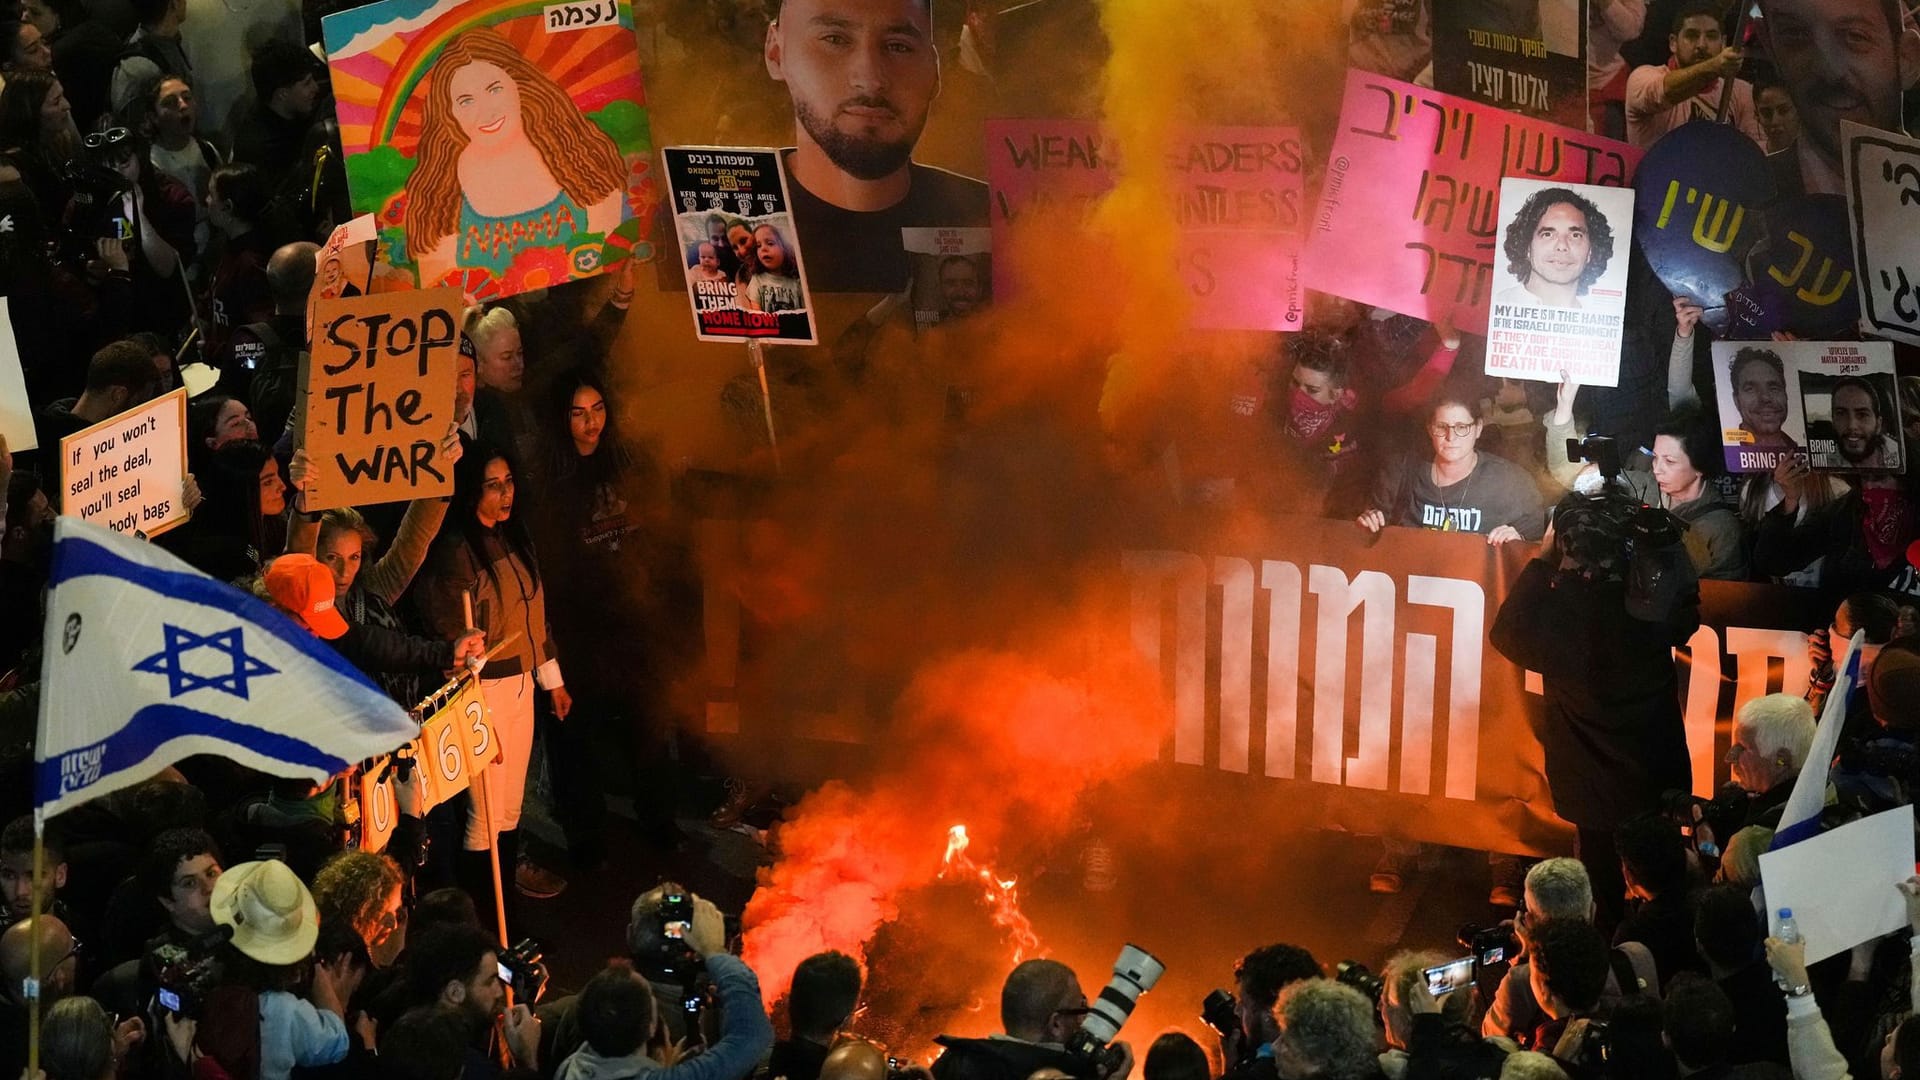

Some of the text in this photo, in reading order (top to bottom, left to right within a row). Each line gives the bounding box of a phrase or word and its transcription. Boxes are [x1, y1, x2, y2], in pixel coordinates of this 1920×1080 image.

[550, 0, 617, 28] נעמה
[1467, 28, 1547, 59] הופקר למוות בשבי
[1467, 60, 1550, 112] אלעד קציר
[1350, 82, 1627, 190] גדעון ויריב
[687, 153, 755, 167] משפחת ביבס
[680, 190, 778, 202] KFIR YARDEN SHIRI ARIEL
[463, 203, 577, 260] NAAMA
[696, 281, 738, 296] BRING
[698, 295, 737, 311] THEM
[1494, 304, 1512, 317] MY
[1513, 306, 1539, 319] LIFE
[1540, 309, 1548, 319] IS
[1557, 310, 1580, 323] THE
[1581, 312, 1621, 327] HANDS
[702, 311, 780, 328] HOME NOW!
[1502, 318, 1513, 329] THE
[1513, 320, 1552, 333] ISRAELI
[1553, 323, 1619, 339] GOVERNMENT
[323, 308, 456, 377] STOP
[1492, 331, 1500, 341] IF
[1503, 332, 1528, 344] THEY
[1529, 333, 1558, 346] DON'T
[1591, 339, 1617, 351] DEAL
[1492, 341, 1524, 355] THEY
[1525, 344, 1549, 358] ARE
[1490, 354, 1537, 371] DEATH
[326, 383, 432, 435] The
[72, 416, 156, 466] If you won't
[1810, 439, 1836, 454] BRING
[71, 447, 152, 496] seal the deal,
[335, 440, 445, 487] WAR
[1740, 452, 1777, 469] BRING
[1811, 453, 1829, 468] HIM
[80, 478, 141, 521] you'll seal
[109, 499, 170, 533] body bags
[1121, 549, 1486, 802] המוות
